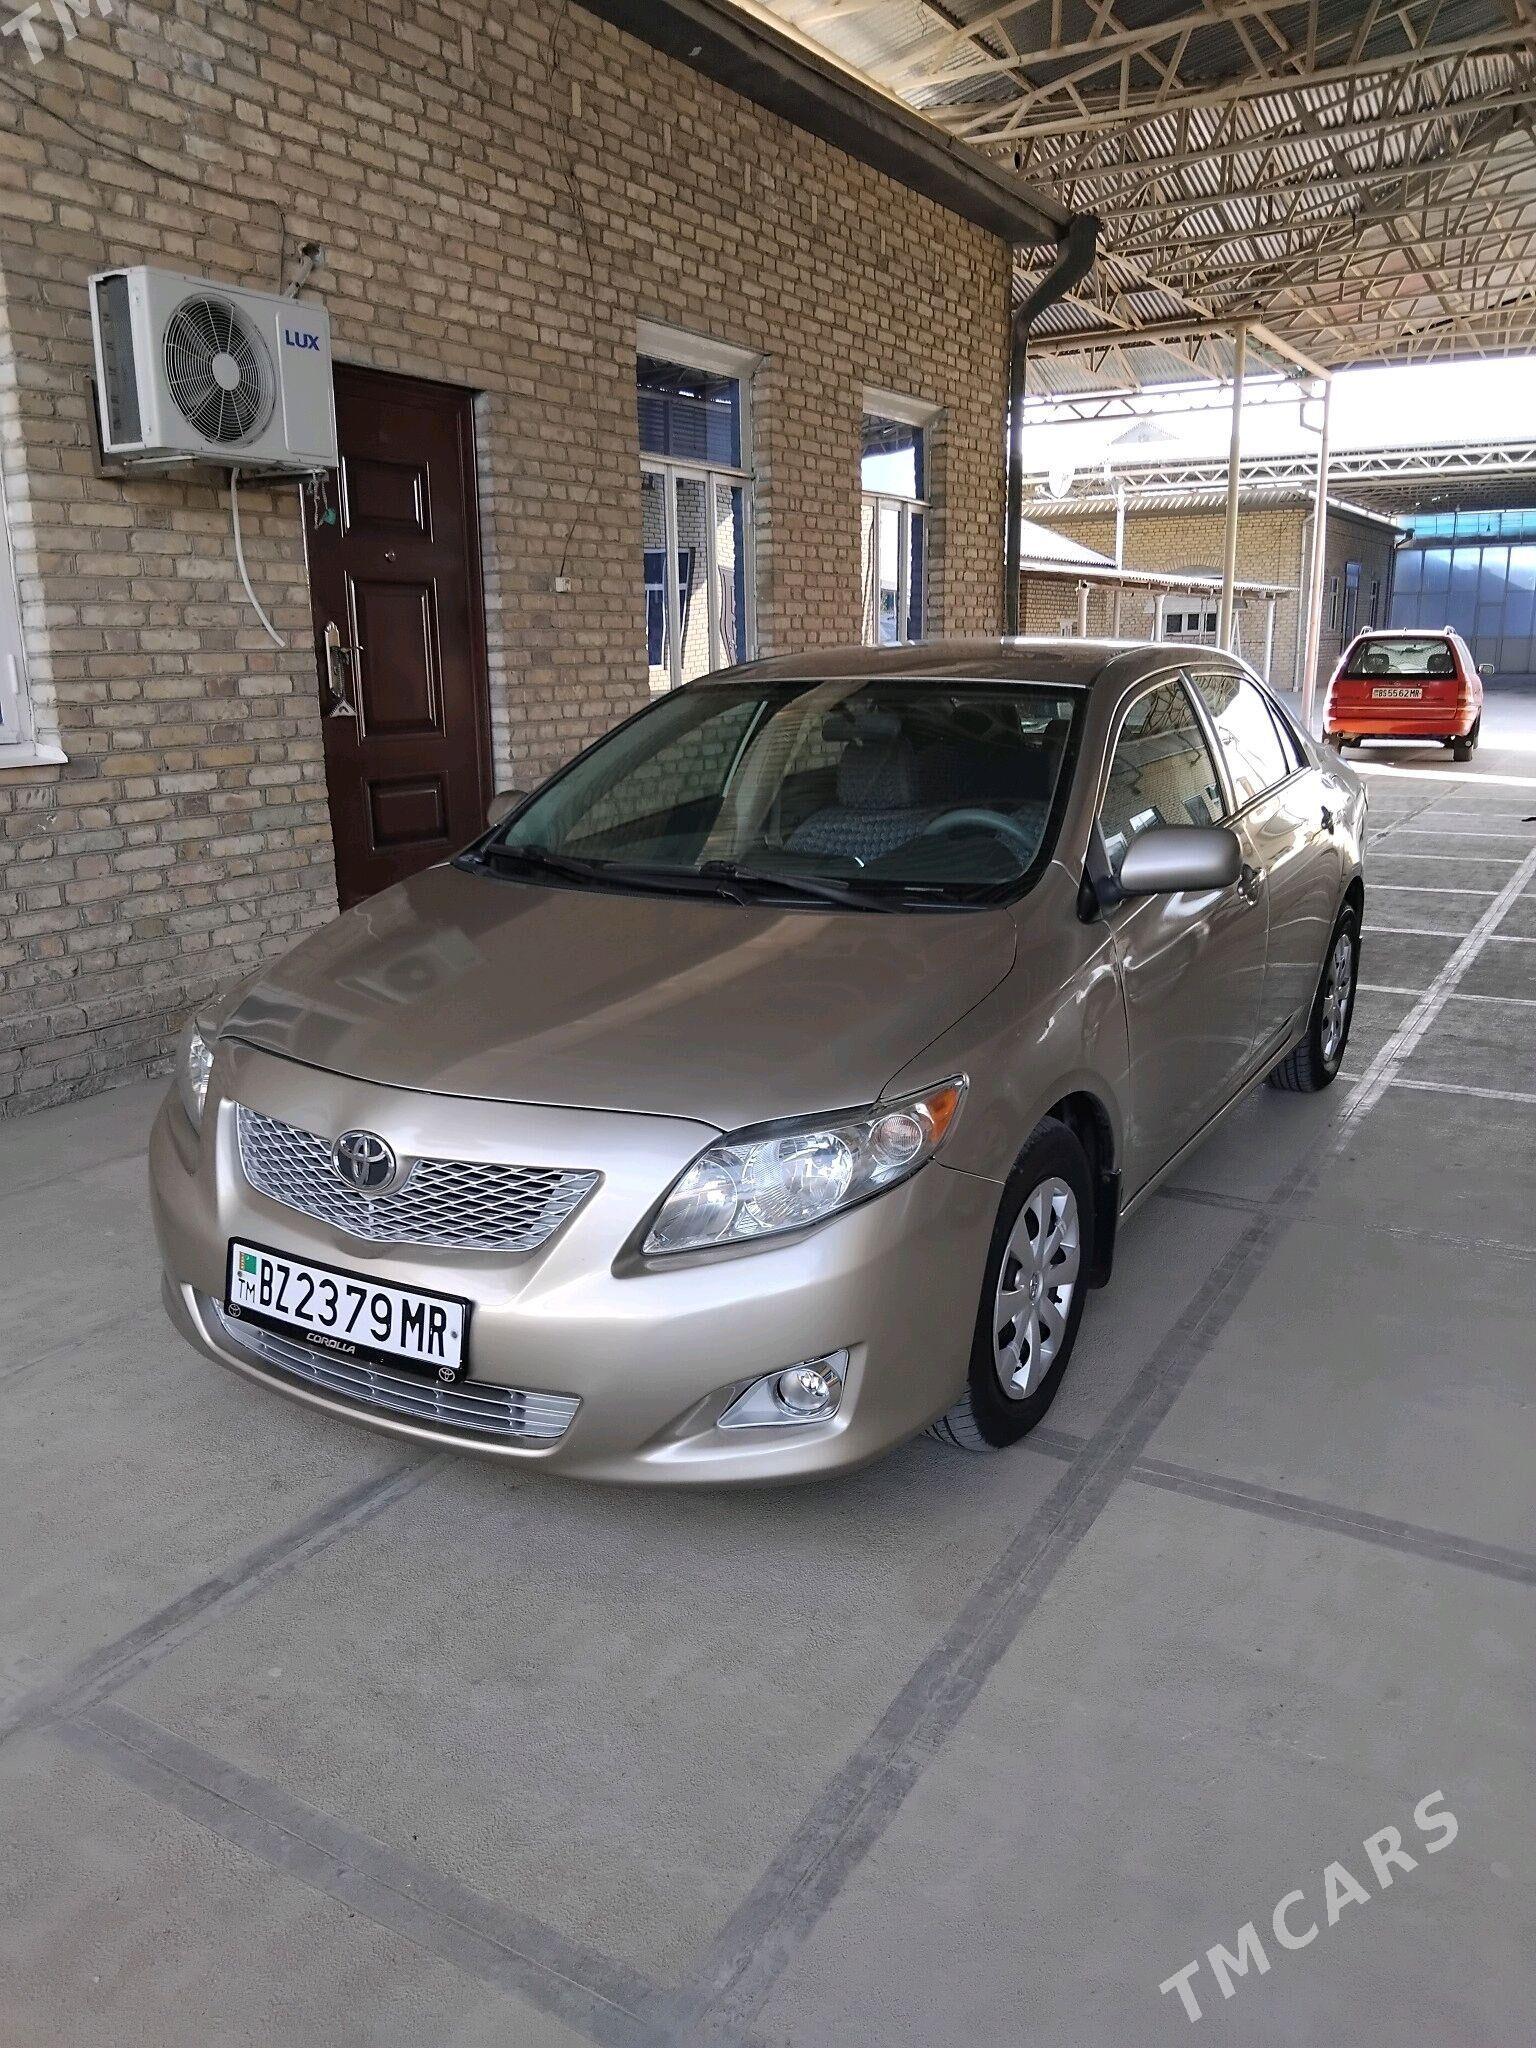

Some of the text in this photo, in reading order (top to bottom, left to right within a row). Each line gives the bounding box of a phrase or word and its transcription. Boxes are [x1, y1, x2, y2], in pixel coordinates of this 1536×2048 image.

[285, 329, 320, 351] LUX
[238, 1278, 256, 1303] TM
[259, 1258, 448, 1358] BZ2379MR
[306, 1332, 356, 1354] COROLLA
